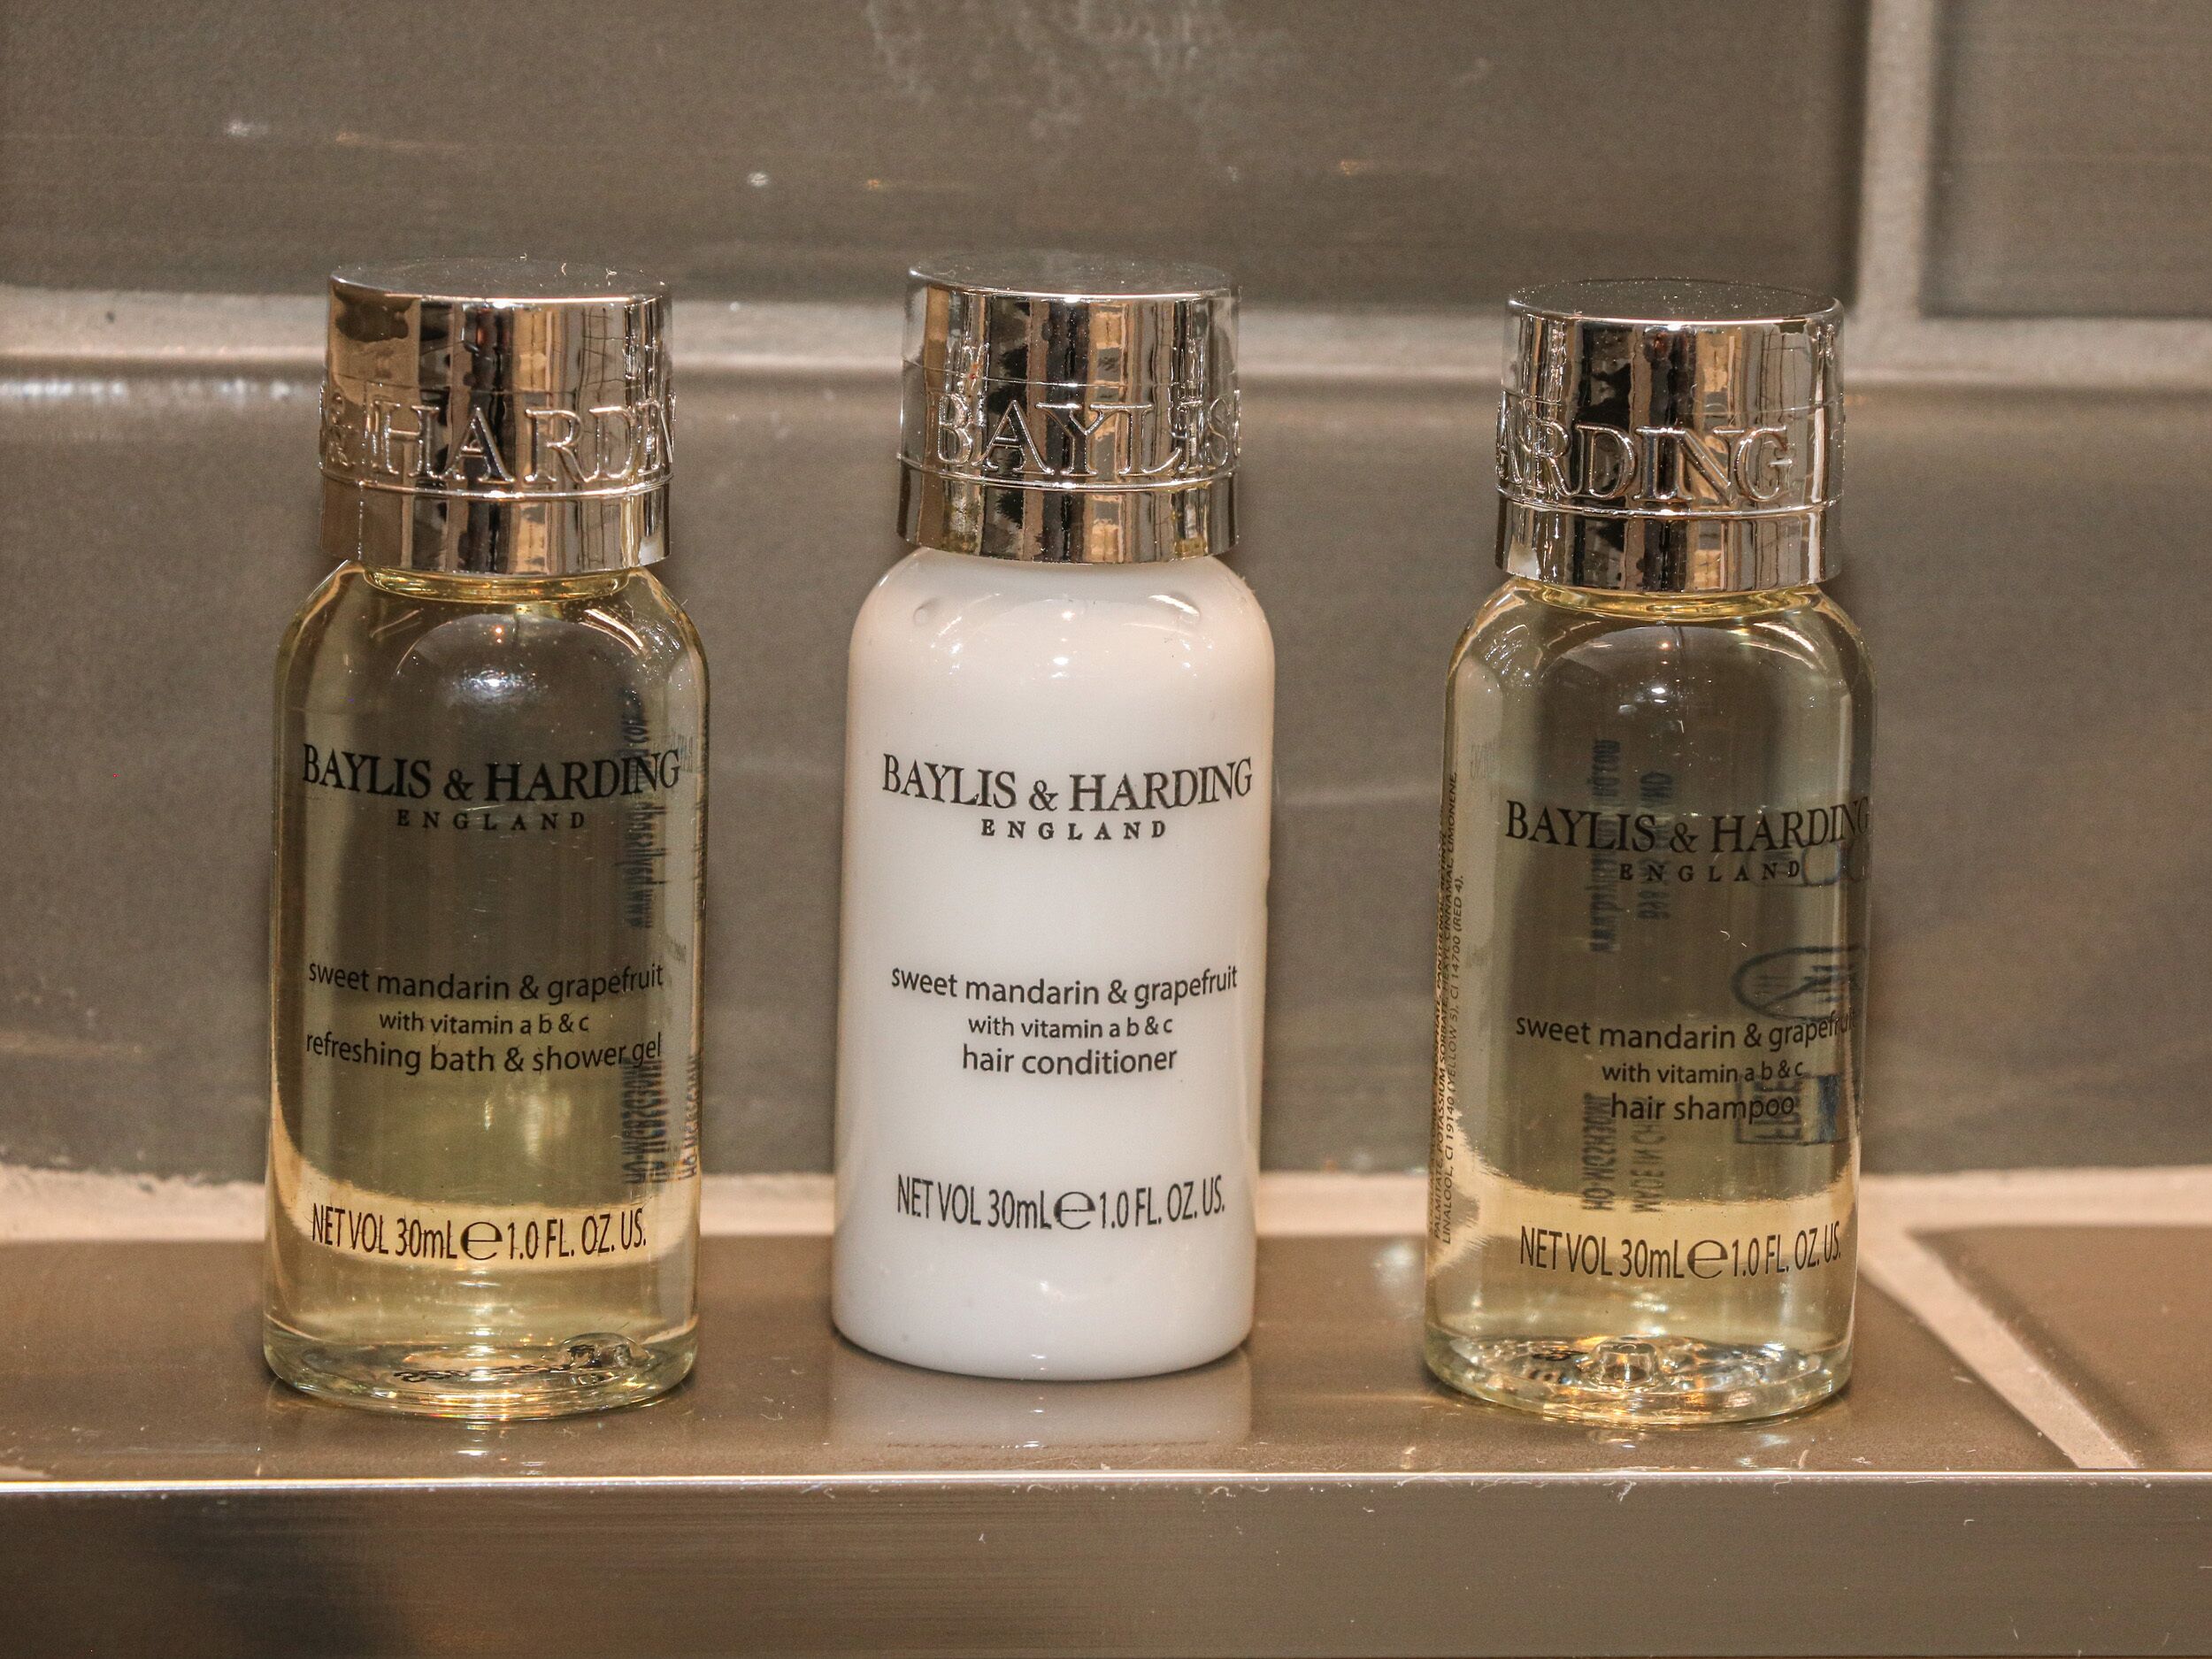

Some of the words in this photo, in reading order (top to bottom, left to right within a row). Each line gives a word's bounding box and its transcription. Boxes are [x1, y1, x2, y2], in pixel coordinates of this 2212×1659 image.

[933, 389, 1230, 477] BAYLIS
[303, 743, 431, 799] BAYLIS
[443, 768, 473, 802] &
[485, 749, 680, 802] HARDING
[882, 753, 1017, 810] BAYLIS
[1028, 780, 1057, 812] &
[1069, 757, 1253, 812] HARDING
[396, 809, 586, 831] ENGLAND
[981, 818, 1167, 841] ENGLAND
[1506, 800, 1656, 853] BAYLIS
[1669, 822, 1698, 854] &
[1711, 796, 1870, 853] HARDING
[1619, 860, 1800, 882] ENGLAND
[309, 962, 370, 992] sweet
[377, 974, 510, 1001] mandarin
[518, 974, 540, 1000] &
[547, 963, 664, 1006] grapefruit
[891, 967, 957, 999] sweet
[965, 976, 1099, 1005] mandarin
[1108, 979, 1127, 1005] &
[1134, 965, 1238, 1010] grapefruit
[379, 1010, 424, 1033] with
[430, 1012, 513, 1035] vitamin
[520, 1019, 533, 1036] a
[539, 1013, 553, 1034] b
[557, 1013, 574, 1033] &
[578, 1016, 589, 1033] c
[968, 1017, 1015, 1037] with
[1021, 1018, 1102, 1040] vitamin
[1109, 1023, 1120, 1039] a
[1126, 1017, 1140, 1037] b
[1144, 1018, 1159, 1036] &
[1163, 1018, 1173, 1035] c
[1517, 1015, 1591, 1046] sweet
[1599, 1021, 1735, 1050] mandarin
[1743, 1023, 1762, 1049] &
[1768, 1010, 1857, 1053] grapefruit
[306, 1032, 421, 1077] refreshing
[430, 1044, 496, 1072] bath
[503, 1046, 525, 1072] &
[533, 1044, 627, 1074] shower
[631, 1033, 663, 1072] gel
[963, 1044, 1015, 1073] hair
[1021, 1048, 1178, 1076] conditioner
[1601, 1061, 1650, 1084] with
[1656, 1063, 1739, 1085] vitamin
[1744, 1067, 1755, 1083] a
[1761, 1060, 1772, 1082] b
[1778, 1059, 1792, 1079] &
[1794, 1061, 1803, 1078] c
[1610, 1092, 1665, 1121] hair
[1673, 1094, 1795, 1126] shampoo
[897, 1173, 933, 1217] NET
[938, 1181, 981, 1227] VOL
[1099, 1187, 1130, 1229] 1.0
[1134, 1187, 1162, 1227] FL.
[1166, 1180, 1197, 1222] OZ.
[1202, 1174, 1225, 1215] US.
[1442, 1165, 1454, 1245] LINALOOL,
[312, 1202, 346, 1248] NET
[348, 1210, 389, 1255] VOL
[508, 1221, 541, 1261] 1.0
[546, 1217, 575, 1259] FL.
[580, 1215, 616, 1257] OZ.
[620, 1206, 647, 1251] US.
[1520, 1225, 1562, 1269] NET
[1565, 1233, 1613, 1276] VOL
[1732, 1238, 1760, 1279] 1.0
[1765, 1233, 1790, 1274] FL.
[1794, 1226, 1820, 1271] OZ.
[1824, 1220, 1841, 1263] US.
